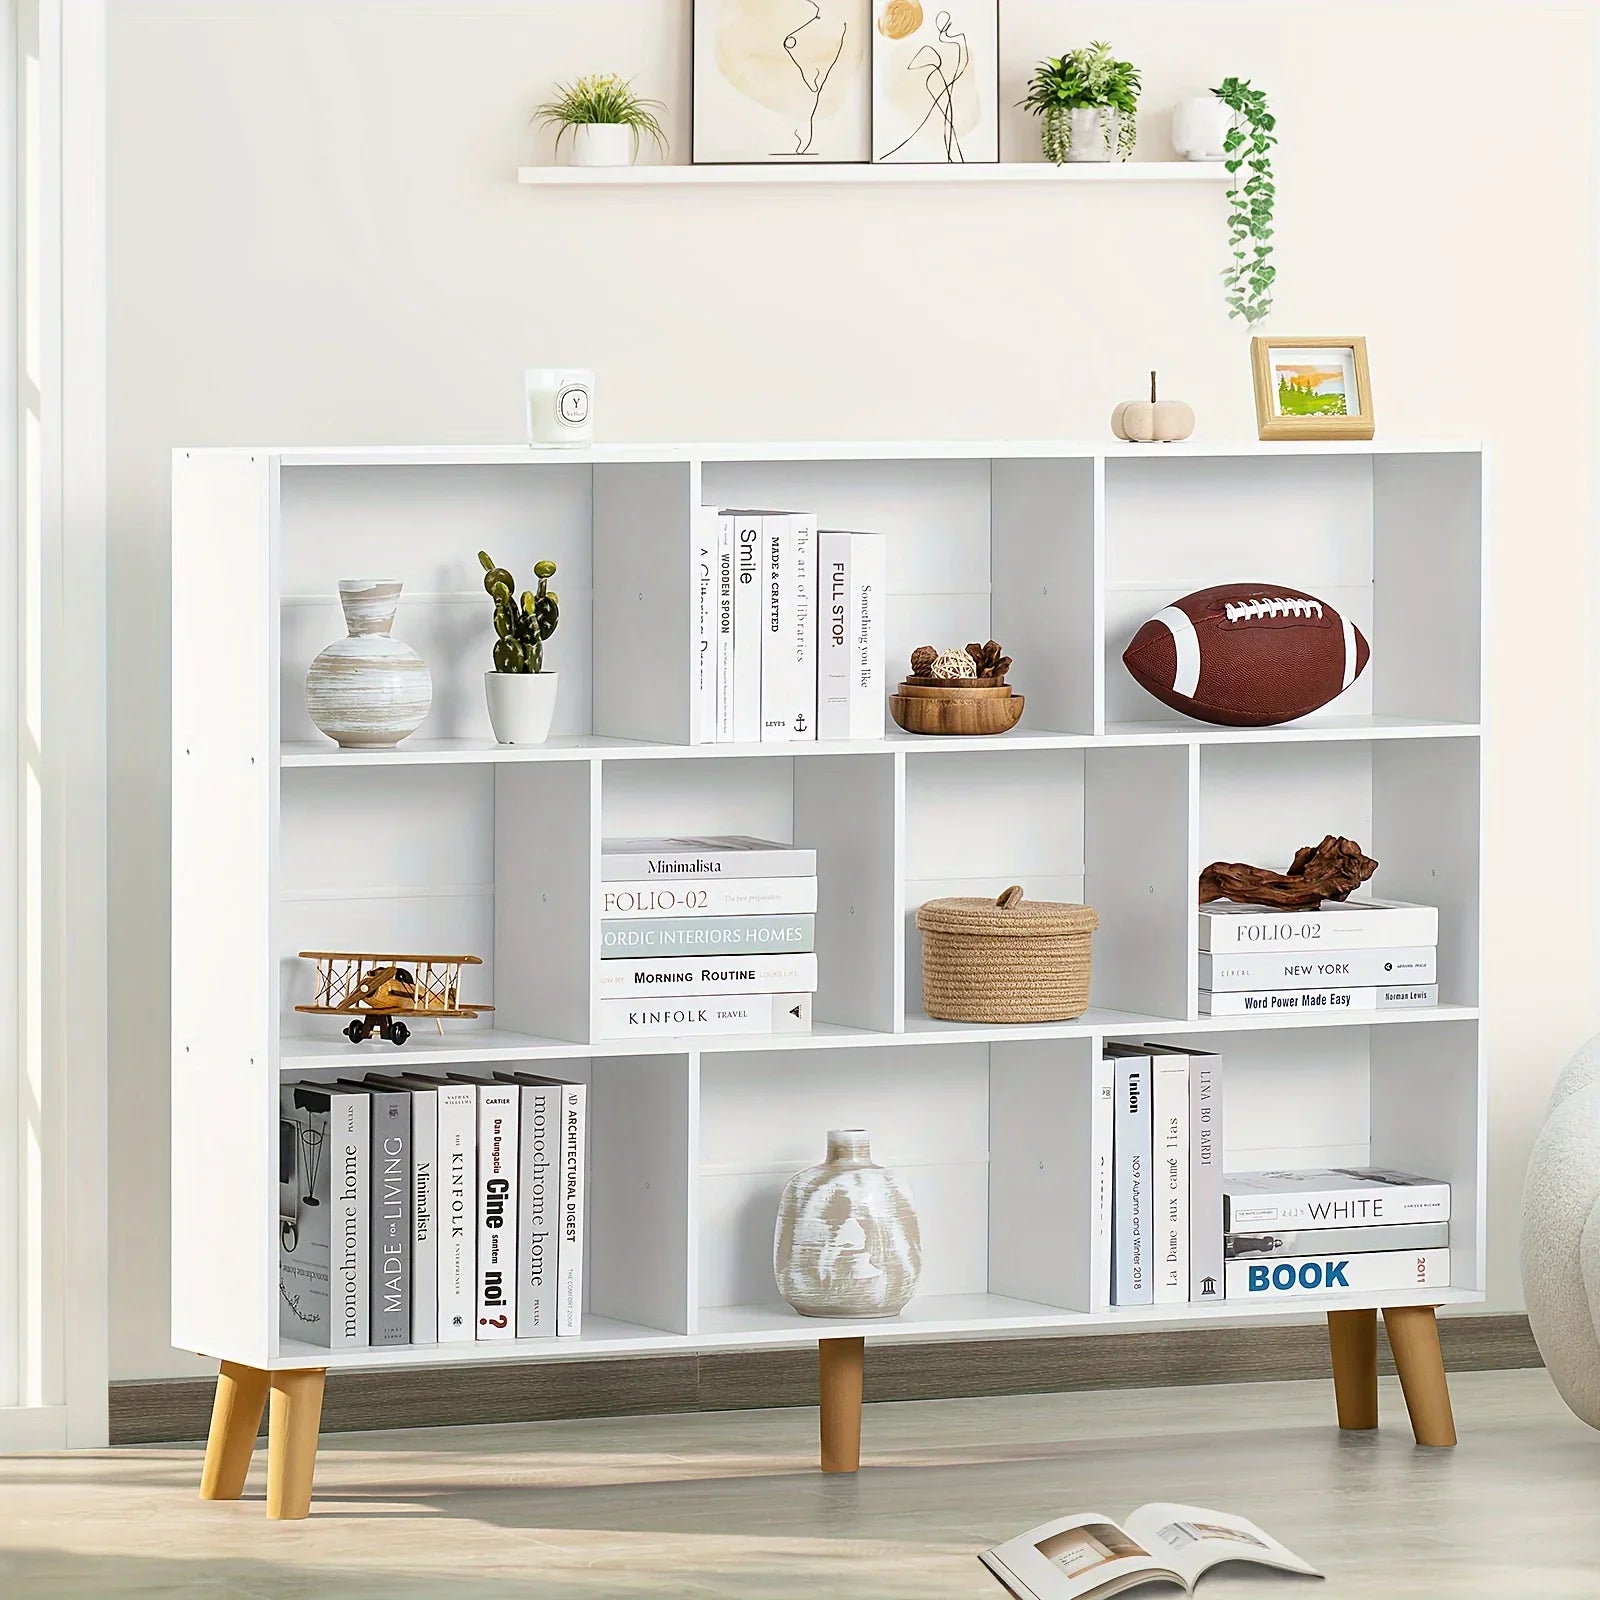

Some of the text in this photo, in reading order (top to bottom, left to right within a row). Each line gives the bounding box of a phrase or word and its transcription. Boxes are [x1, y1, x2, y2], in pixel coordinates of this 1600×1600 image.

[573, 398, 580, 408] Y
[740, 529, 757, 584] Smile
[797, 527, 808, 553] The
[721, 554, 730, 596] WOODEN
[771, 536, 780, 633] MADE & CRAFTED
[797, 584, 808, 600] of
[721, 599, 730, 634] SPOON
[832, 563, 844, 648] FULL STOP.
[796, 603, 808, 662] libraries
[858, 585, 871, 688] Something you like
[647, 859, 721, 874] Minimalista
[604, 891, 708, 911] FOLIO-02
[601, 927, 802, 946] ORDIC INTERIORS HOMES
[1237, 923, 1321, 941] FOLIO-02
[1285, 965, 1313, 976] NEW
[1317, 964, 1350, 974] YORK
[1245, 993, 1351, 1009] Word Power Made Easy
[1385, 991, 1427, 1001] Norman Lewis
[629, 1010, 748, 1025] KINFOLK TRAVEL
[568, 1093, 577, 1105] AD
[1129, 1073, 1139, 1114] Union
[1167, 1117, 1178, 1148] lias
[1201, 1071, 1211, 1165] LINA BO BARDI
[491, 1119, 502, 1174] Dan Dungaciu
[532, 1095, 550, 1226] monochrome
[567, 1110, 577, 1201] ARCHITECTURAL
[340, 1145, 357, 1201] home
[384, 1137, 402, 1219] LIVING
[417, 1162, 430, 1242] Minimalista
[452, 1153, 463, 1237] KINFOLK
[486, 1179, 509, 1229] Cine
[1170, 1199, 1178, 1222] aux
[1308, 1199, 1383, 1220] WHITE
[566, 1203, 576, 1243] DIGEST
[1132, 1155, 1141, 1289] NO.9 Autumn and Winter 2018
[531, 1232, 548, 1287] home
[1167, 1230, 1178, 1263] Dame
[340, 1207, 357, 1338] monochrome
[384, 1243, 402, 1312] MADE
[1167, 1270, 1178, 1286] La
[1249, 1260, 1350, 1292] BOOK
[1417, 1257, 1426, 1283] 2011
[484, 1271, 506, 1306] noi
[479, 1315, 508, 1329] ?
